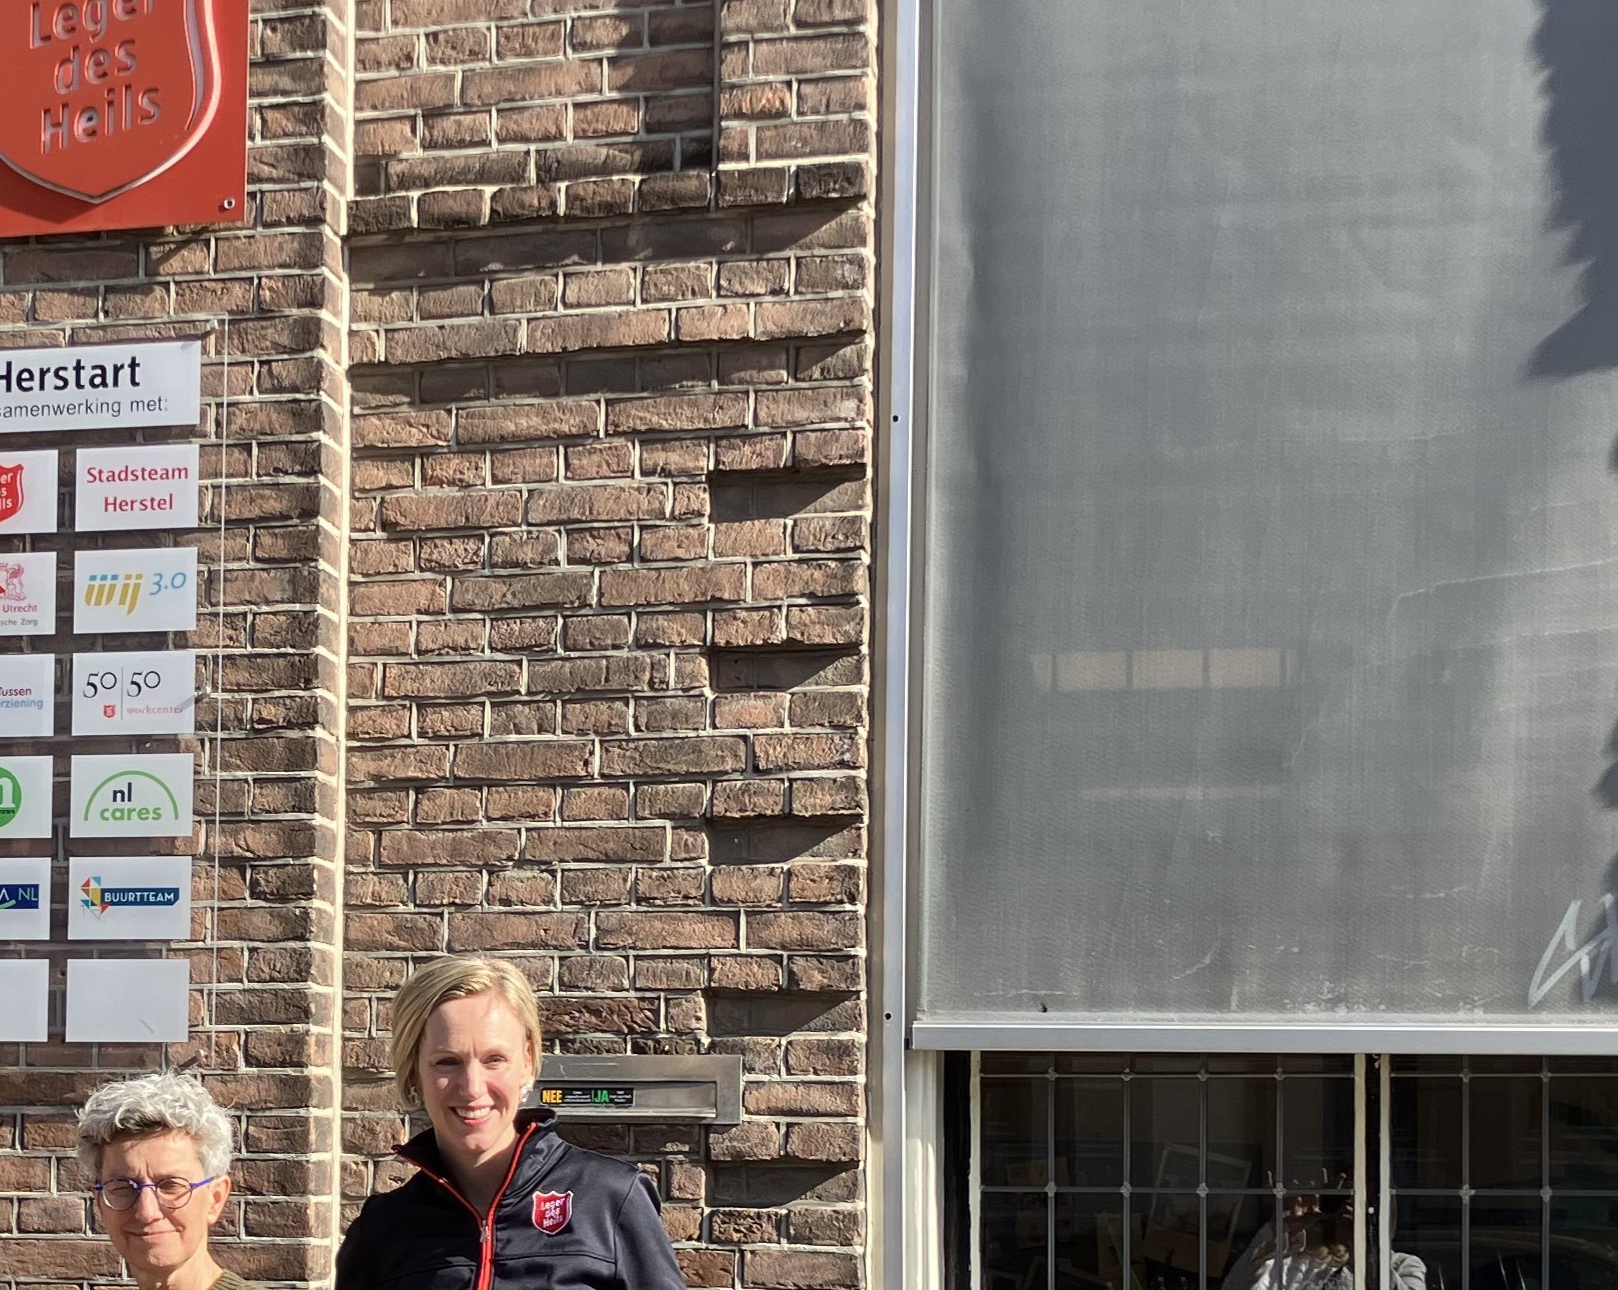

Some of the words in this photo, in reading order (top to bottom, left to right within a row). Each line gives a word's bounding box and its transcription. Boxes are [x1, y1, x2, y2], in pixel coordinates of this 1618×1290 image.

[54, 39, 138, 95] des
[41, 84, 161, 155] Heils
[130, 395, 168, 413] met:
[86, 465, 189, 484] Stadsteam
[103, 493, 174, 512] Herstel
[149, 571, 187, 596] 3.0
[2, 603, 38, 613] Utrecht
[20, 618, 38, 627] Zorg
[83, 671, 117, 698] 50
[126, 670, 161, 697] 50
[126, 704, 184, 715] workcenter
[112, 782, 132, 803] nl
[99, 805, 163, 822] cares
[18, 887, 39, 902] NL
[104, 891, 175, 903] BUURTTEAM
[542, 1089, 563, 1104] NEE
[594, 1089, 610, 1103] JA
